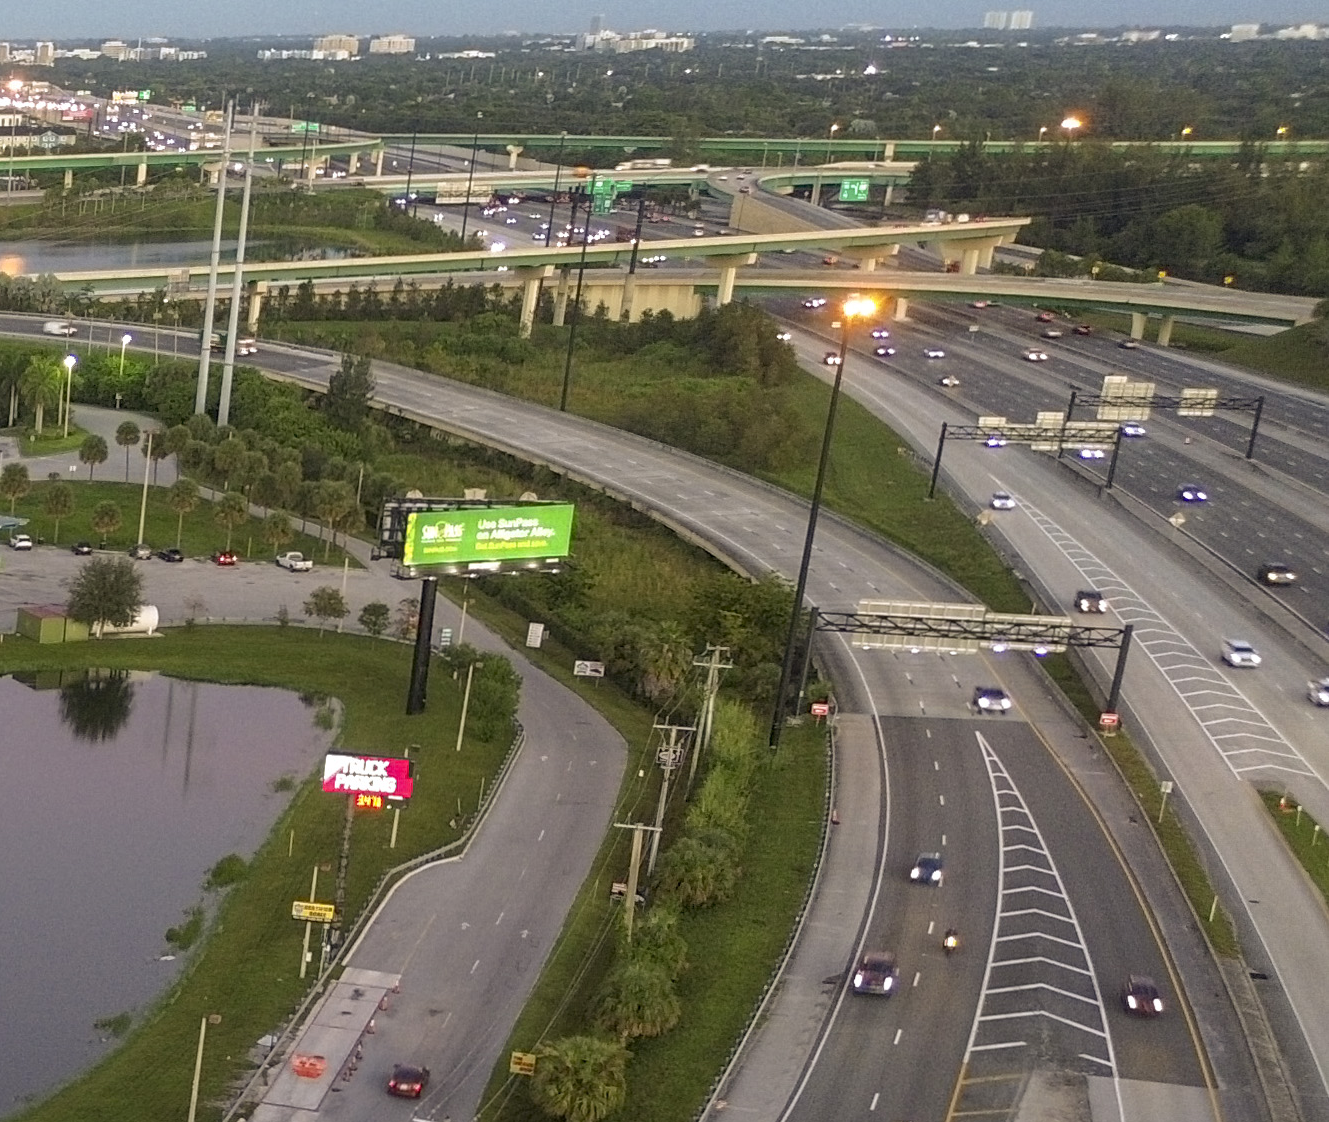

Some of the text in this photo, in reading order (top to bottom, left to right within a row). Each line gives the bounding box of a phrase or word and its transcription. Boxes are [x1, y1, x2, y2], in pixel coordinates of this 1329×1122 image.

[477, 517, 539, 530] Use SunPass
[339, 757, 390, 777] TRUCK
[334, 773, 397, 793] PARKING
